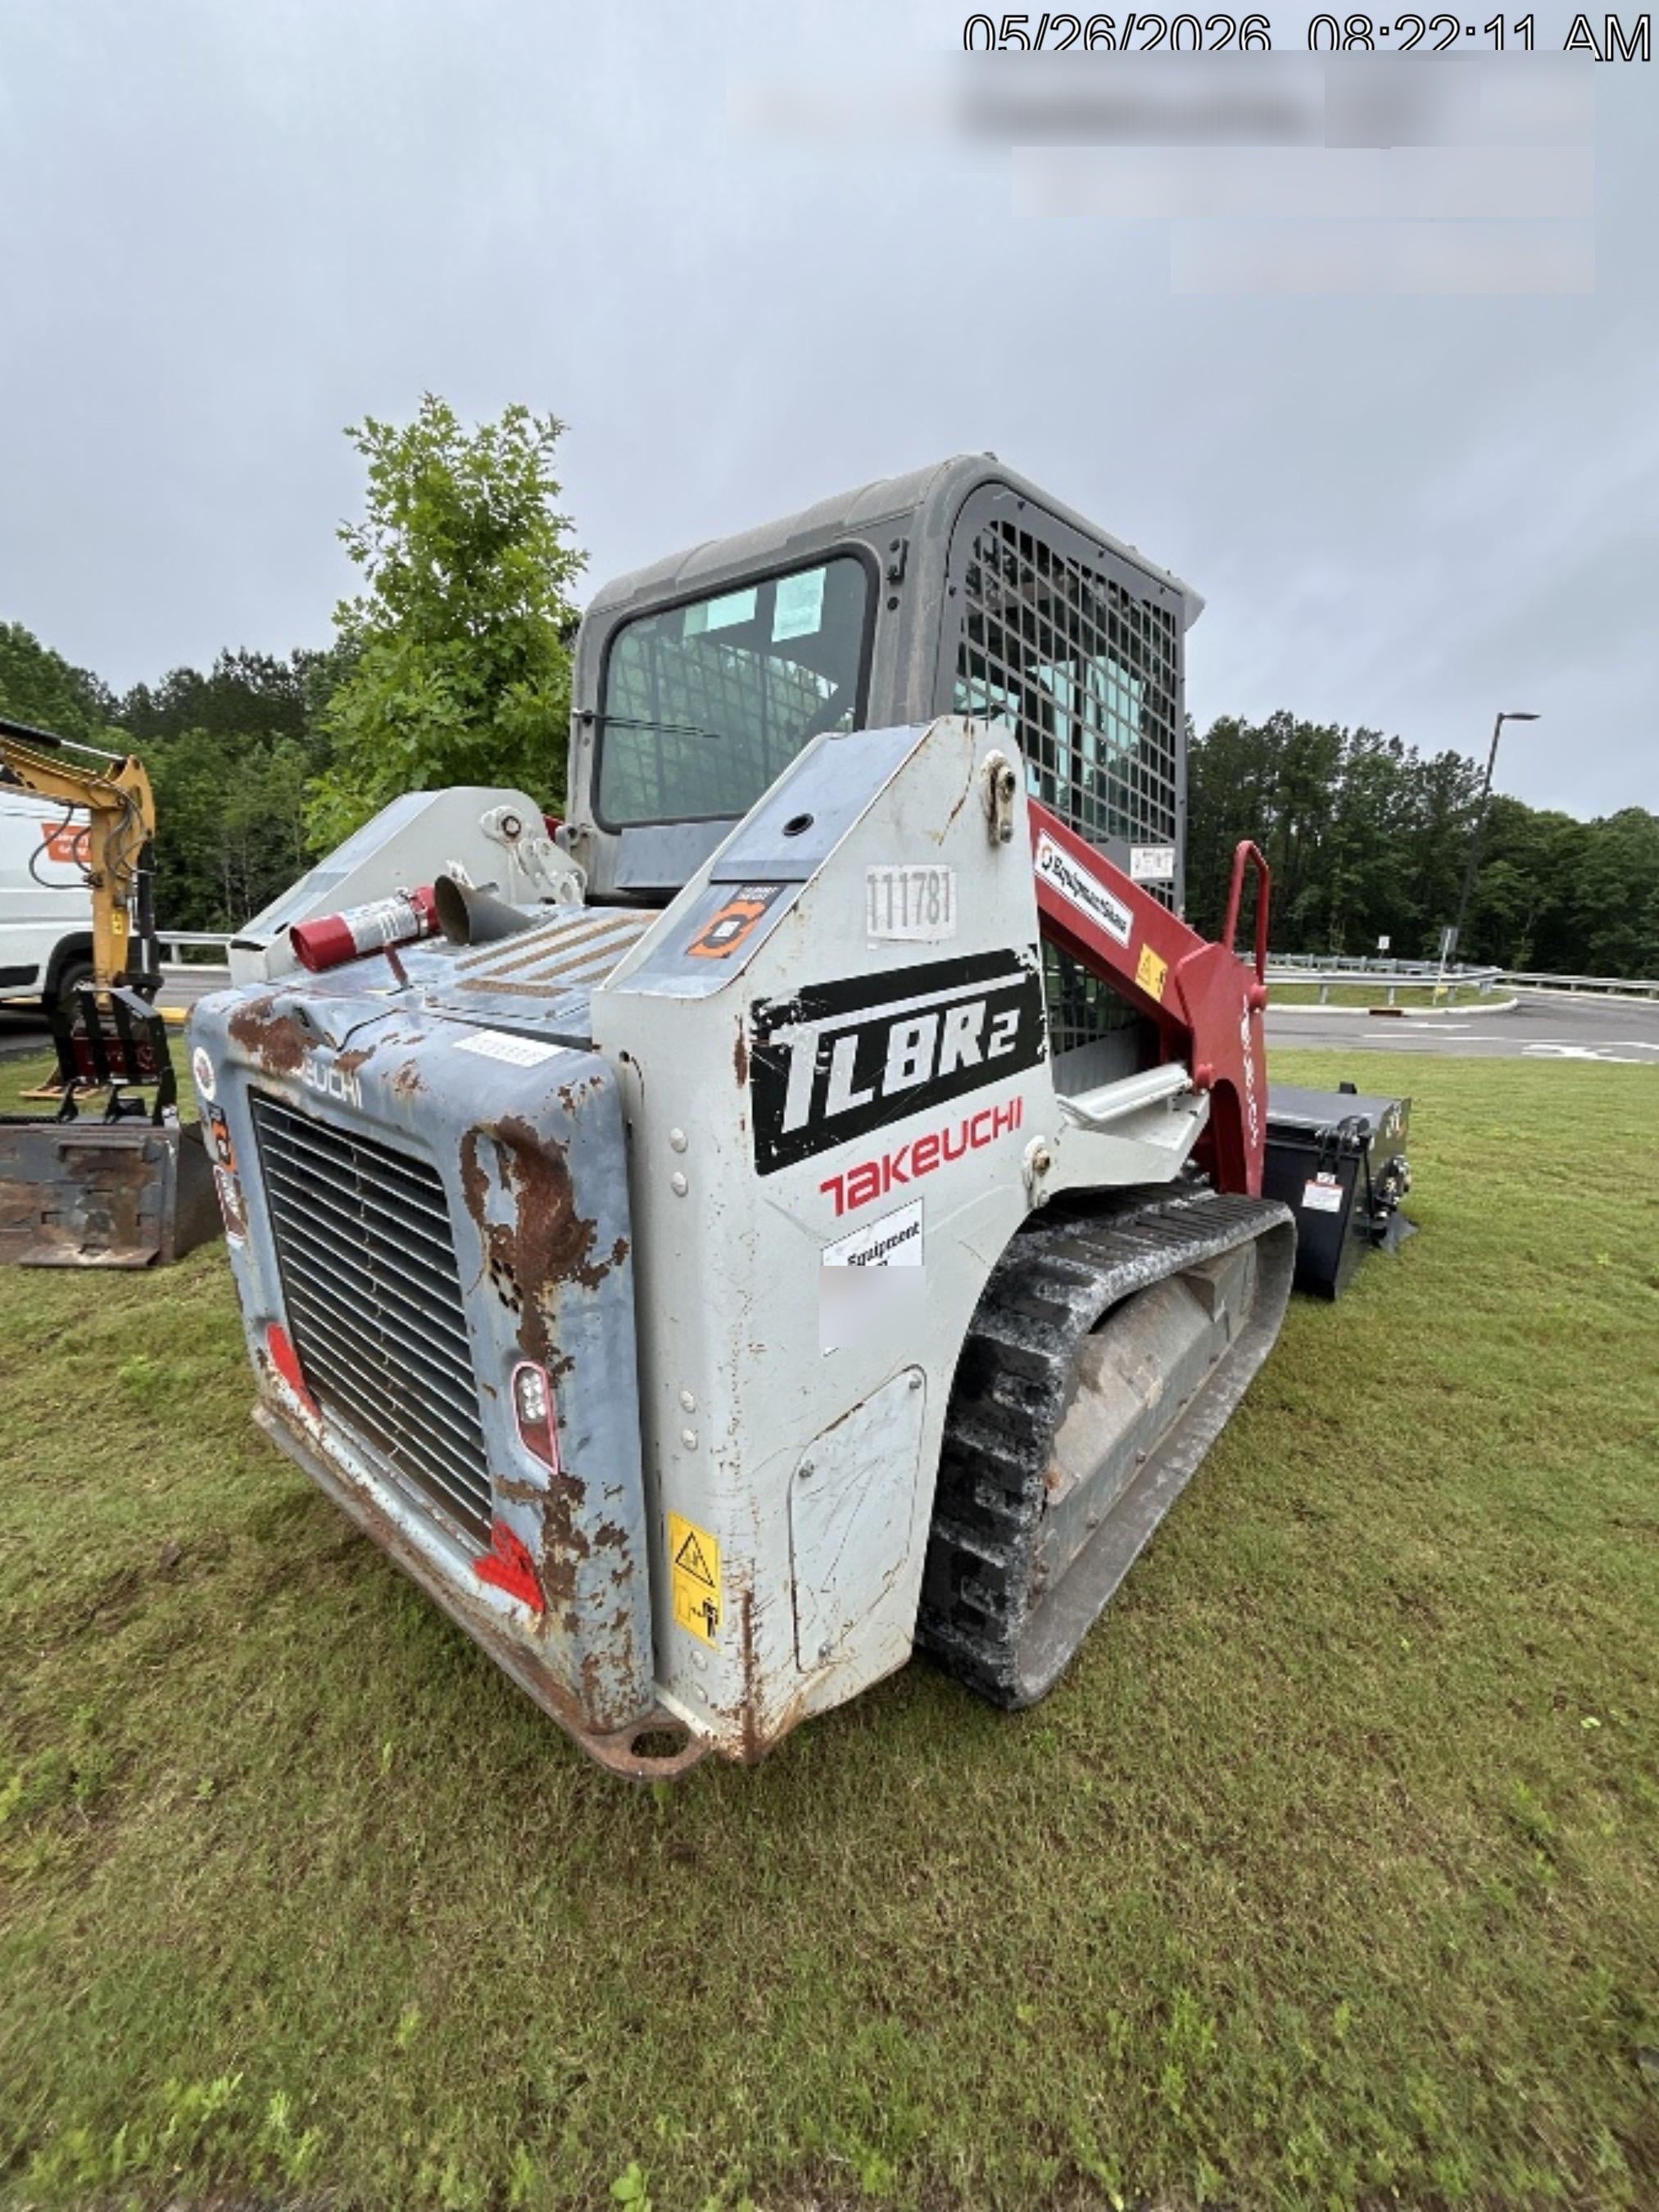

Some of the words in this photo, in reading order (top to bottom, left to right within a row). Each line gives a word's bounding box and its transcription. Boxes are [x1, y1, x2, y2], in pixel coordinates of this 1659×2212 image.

[868, 870, 950, 931] 111781
[820, 1095, 1022, 1217] TAKEUCHI
[847, 1221, 921, 1266] Equipment
